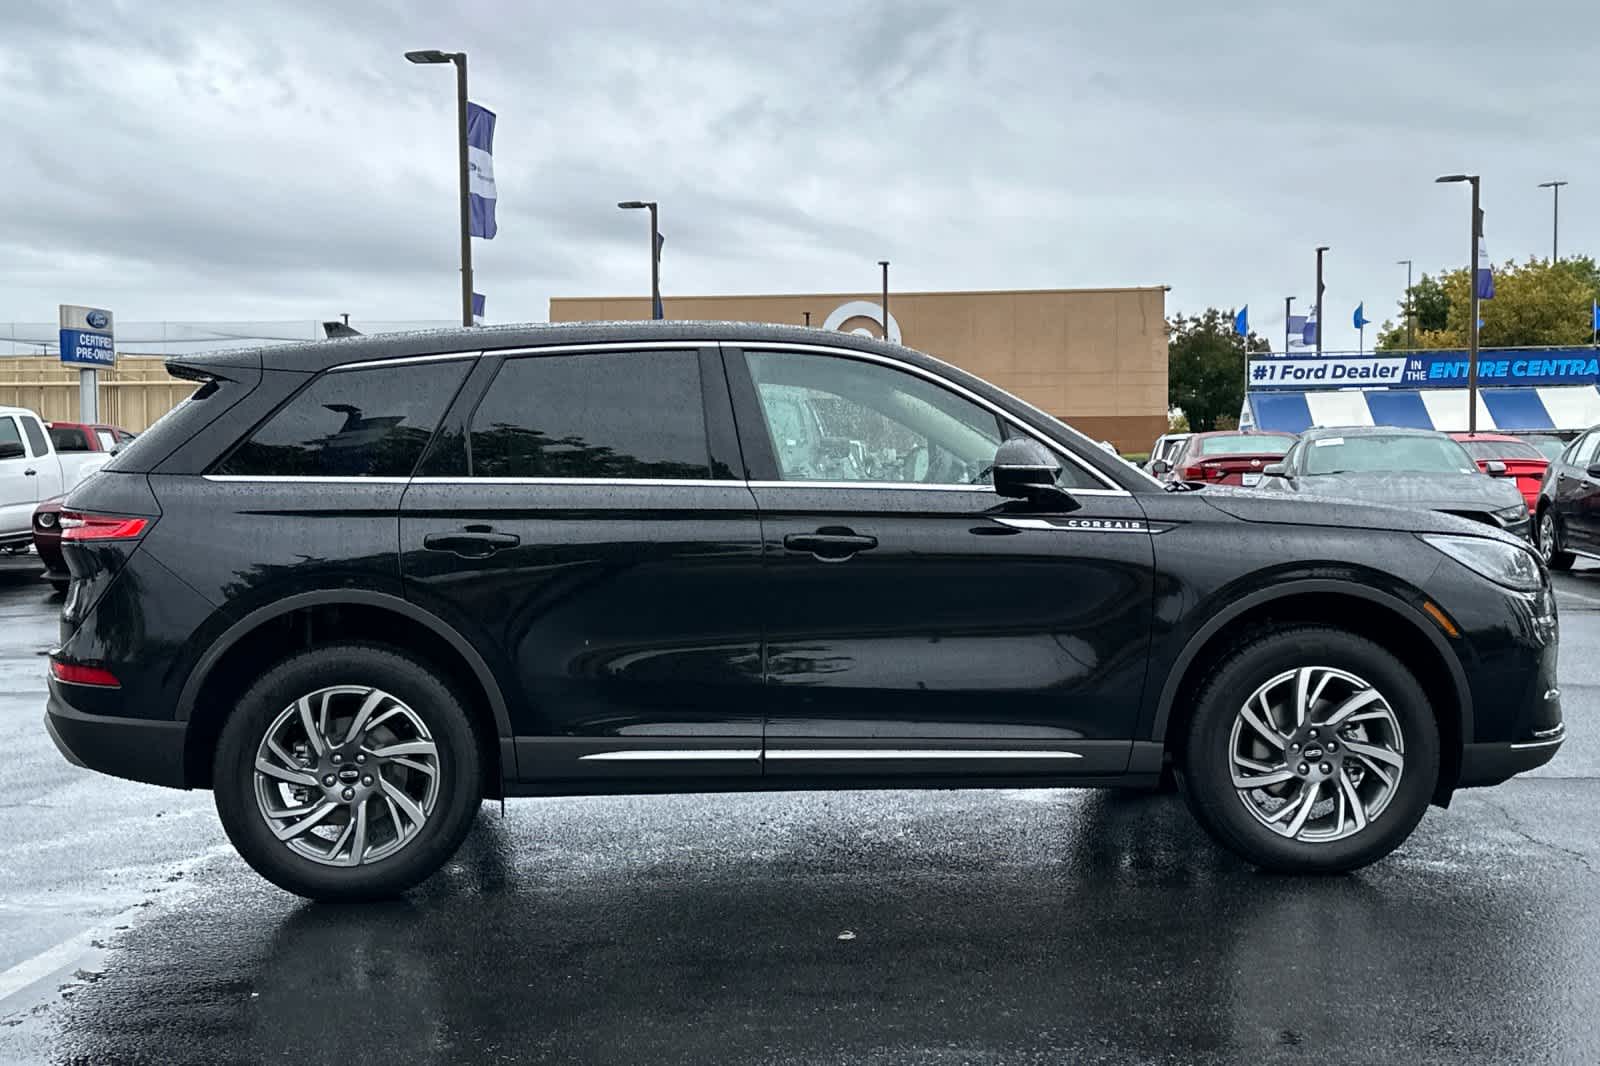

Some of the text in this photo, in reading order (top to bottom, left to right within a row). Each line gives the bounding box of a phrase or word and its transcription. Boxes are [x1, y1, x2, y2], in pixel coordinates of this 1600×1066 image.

[76, 347, 113, 361] PRE-OWNED
[1411, 360, 1422, 370] IN
[1252, 362, 1399, 380] #1 Ford Dealer
[1406, 371, 1427, 381] THE
[1068, 520, 1140, 528] CORSAIR
